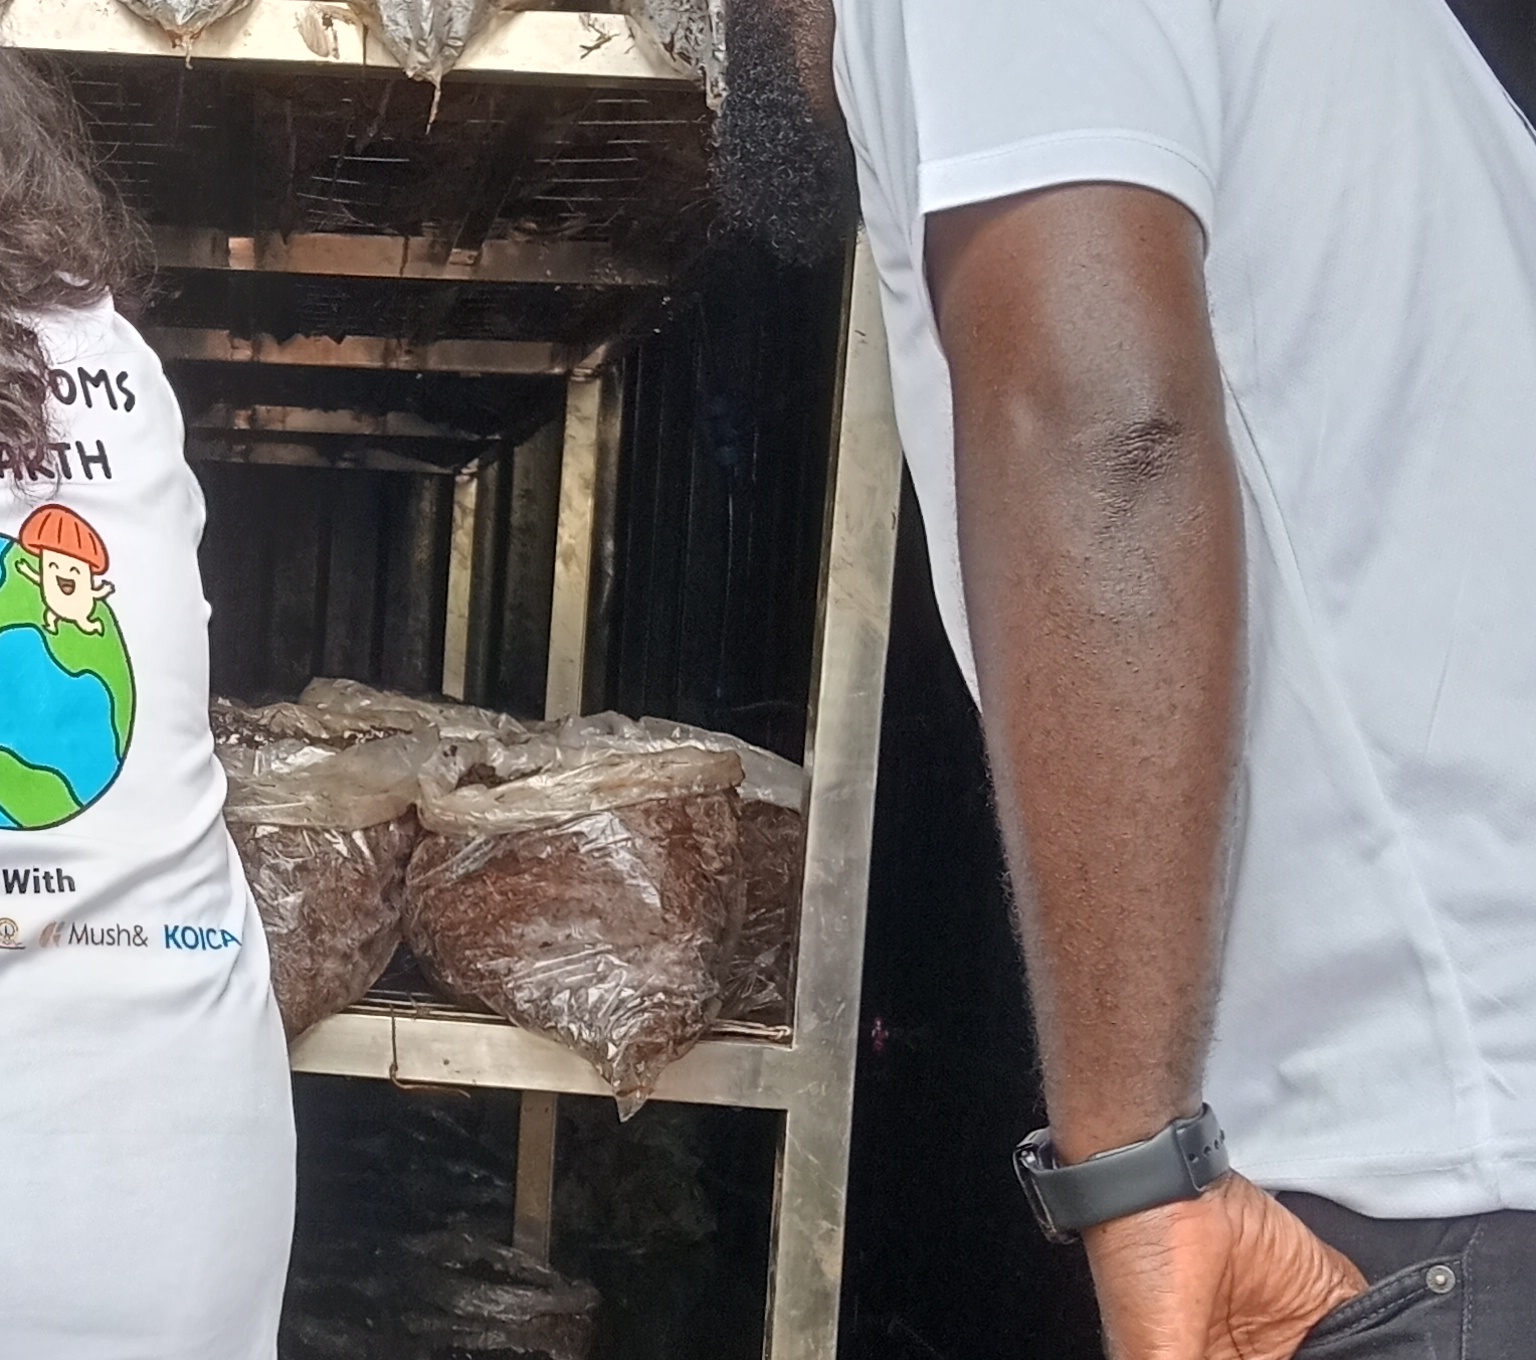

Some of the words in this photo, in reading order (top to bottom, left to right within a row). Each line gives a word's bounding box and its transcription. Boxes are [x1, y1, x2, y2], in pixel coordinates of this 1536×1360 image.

[2, 867, 76, 895] With
[68, 922, 148, 947] Mush&
[164, 924, 243, 950] KOICA
